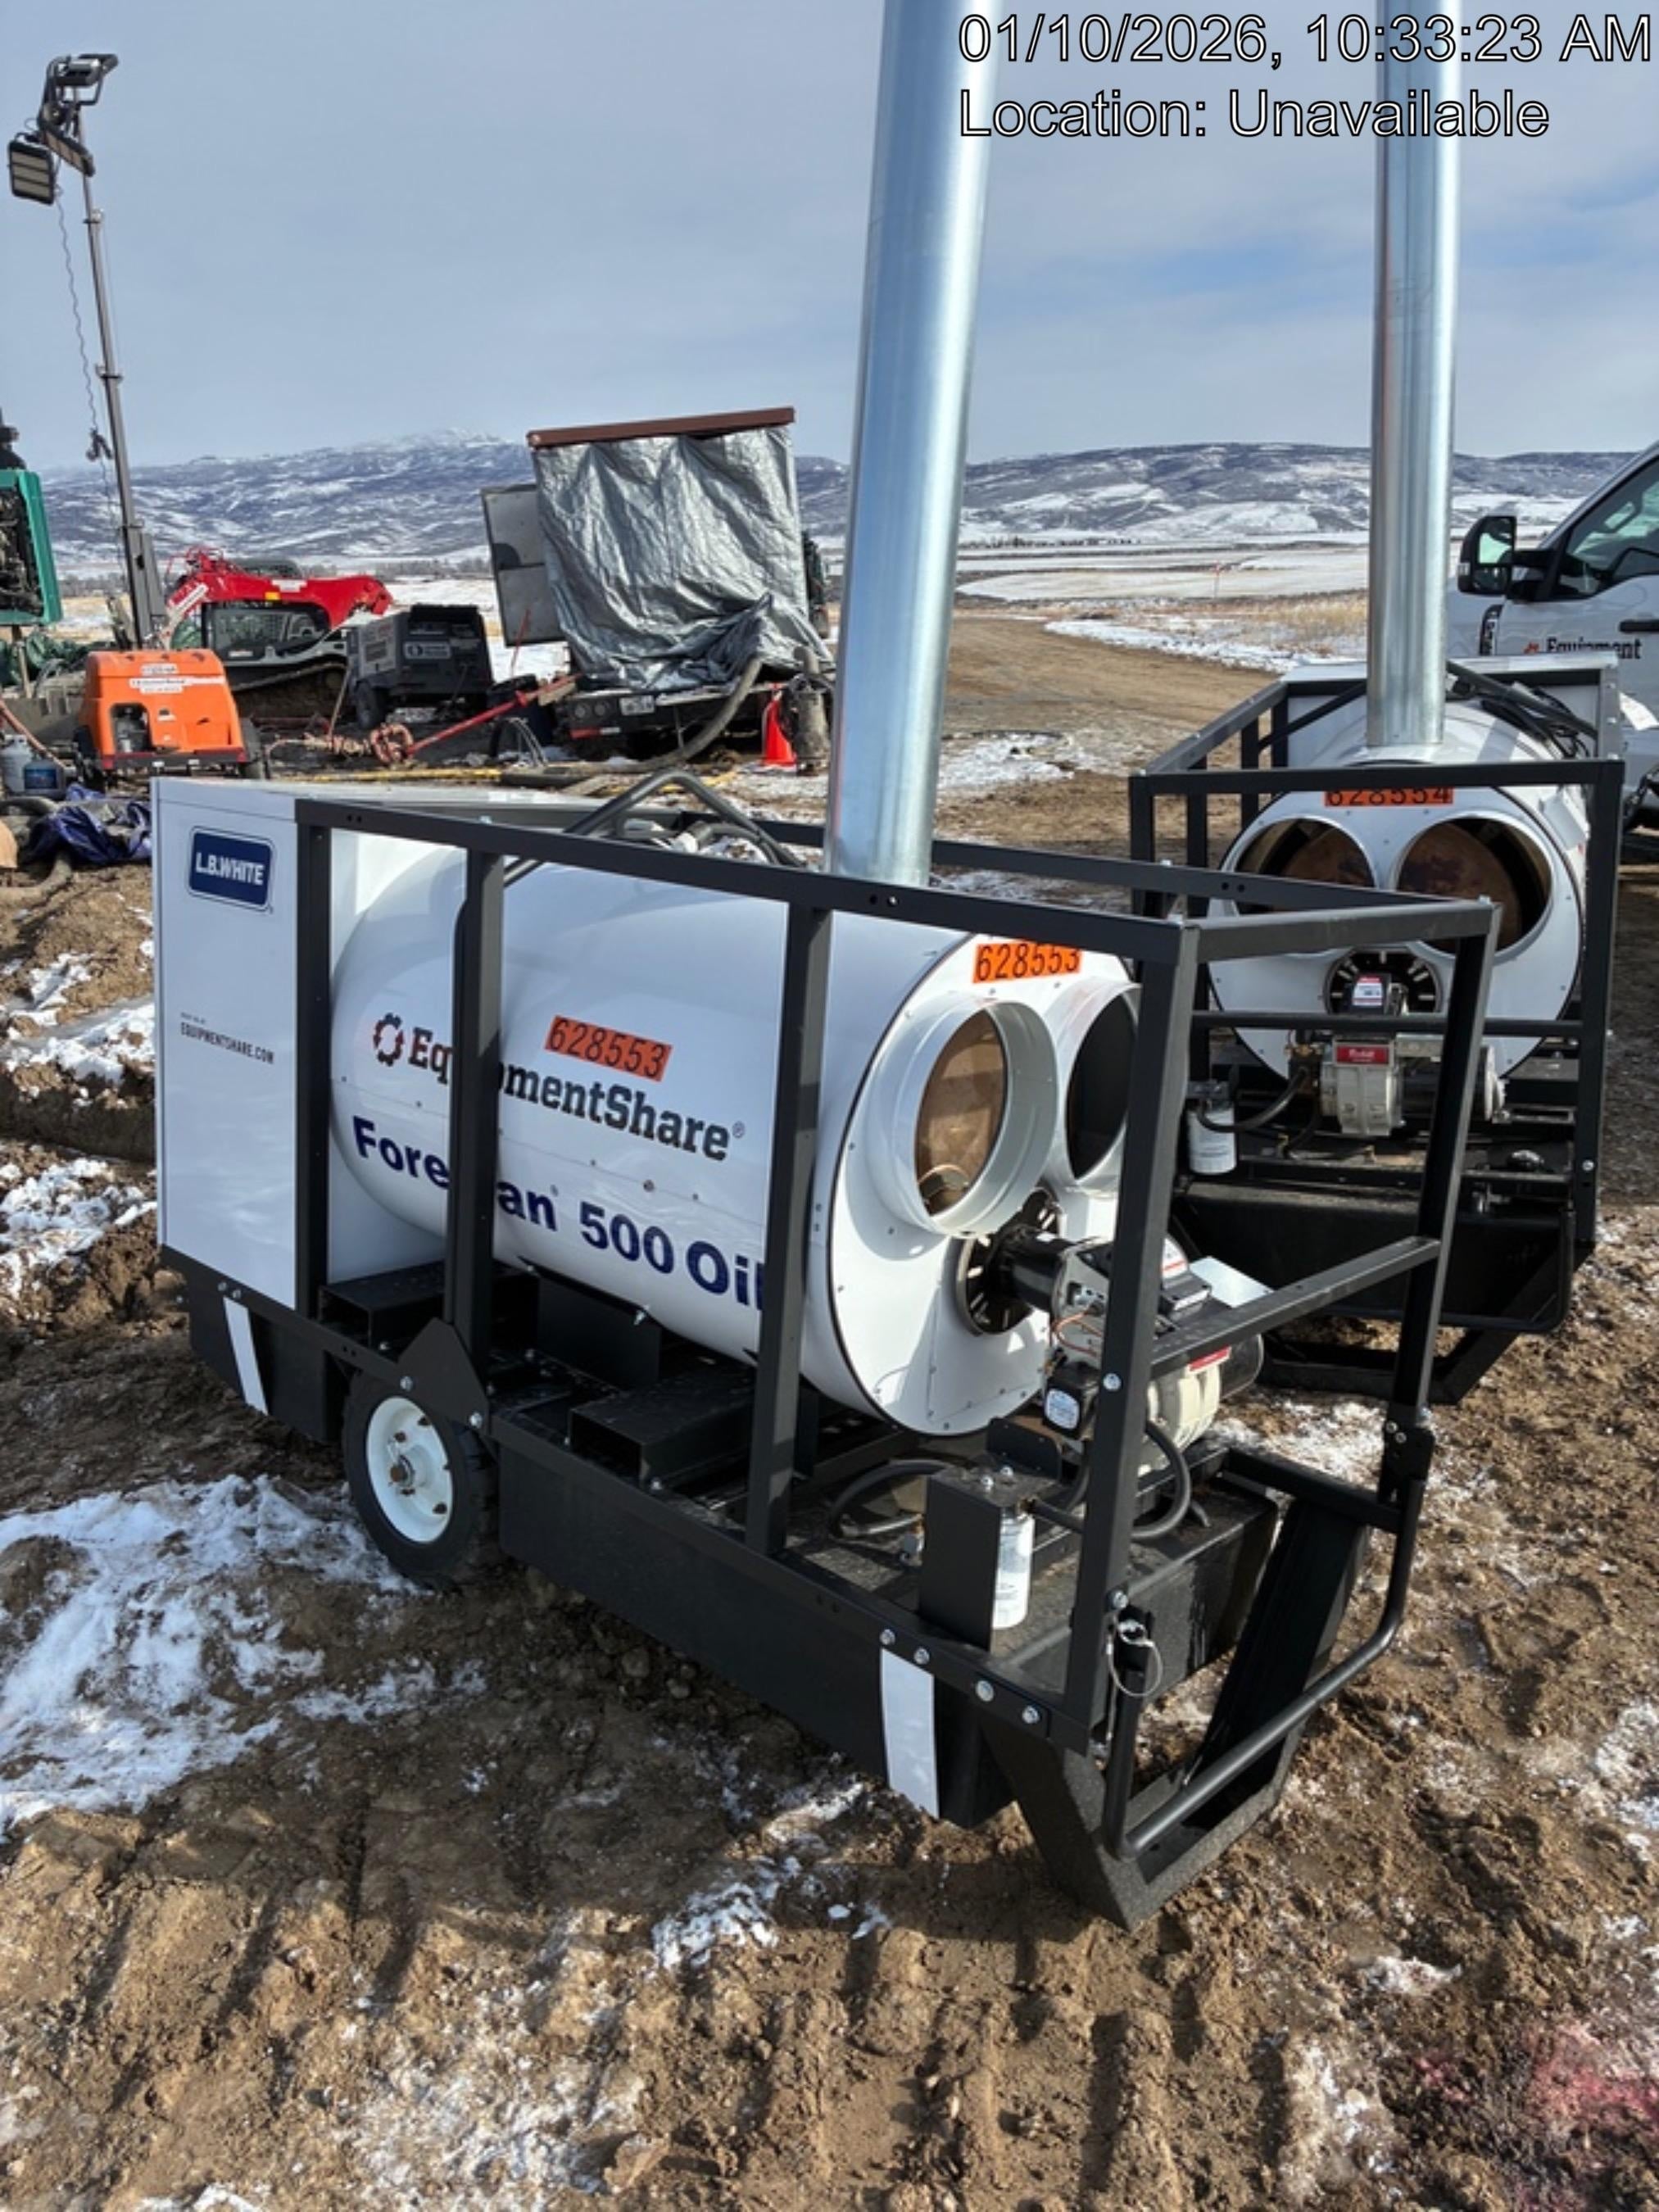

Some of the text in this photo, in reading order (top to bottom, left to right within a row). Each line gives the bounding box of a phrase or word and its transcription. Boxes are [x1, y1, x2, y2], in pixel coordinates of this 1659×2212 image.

[977, 943, 1081, 981] 628553
[546, 1018, 667, 1078] 628553
[352, 1115, 558, 1231] Forean
[579, 1201, 674, 1275] 500
